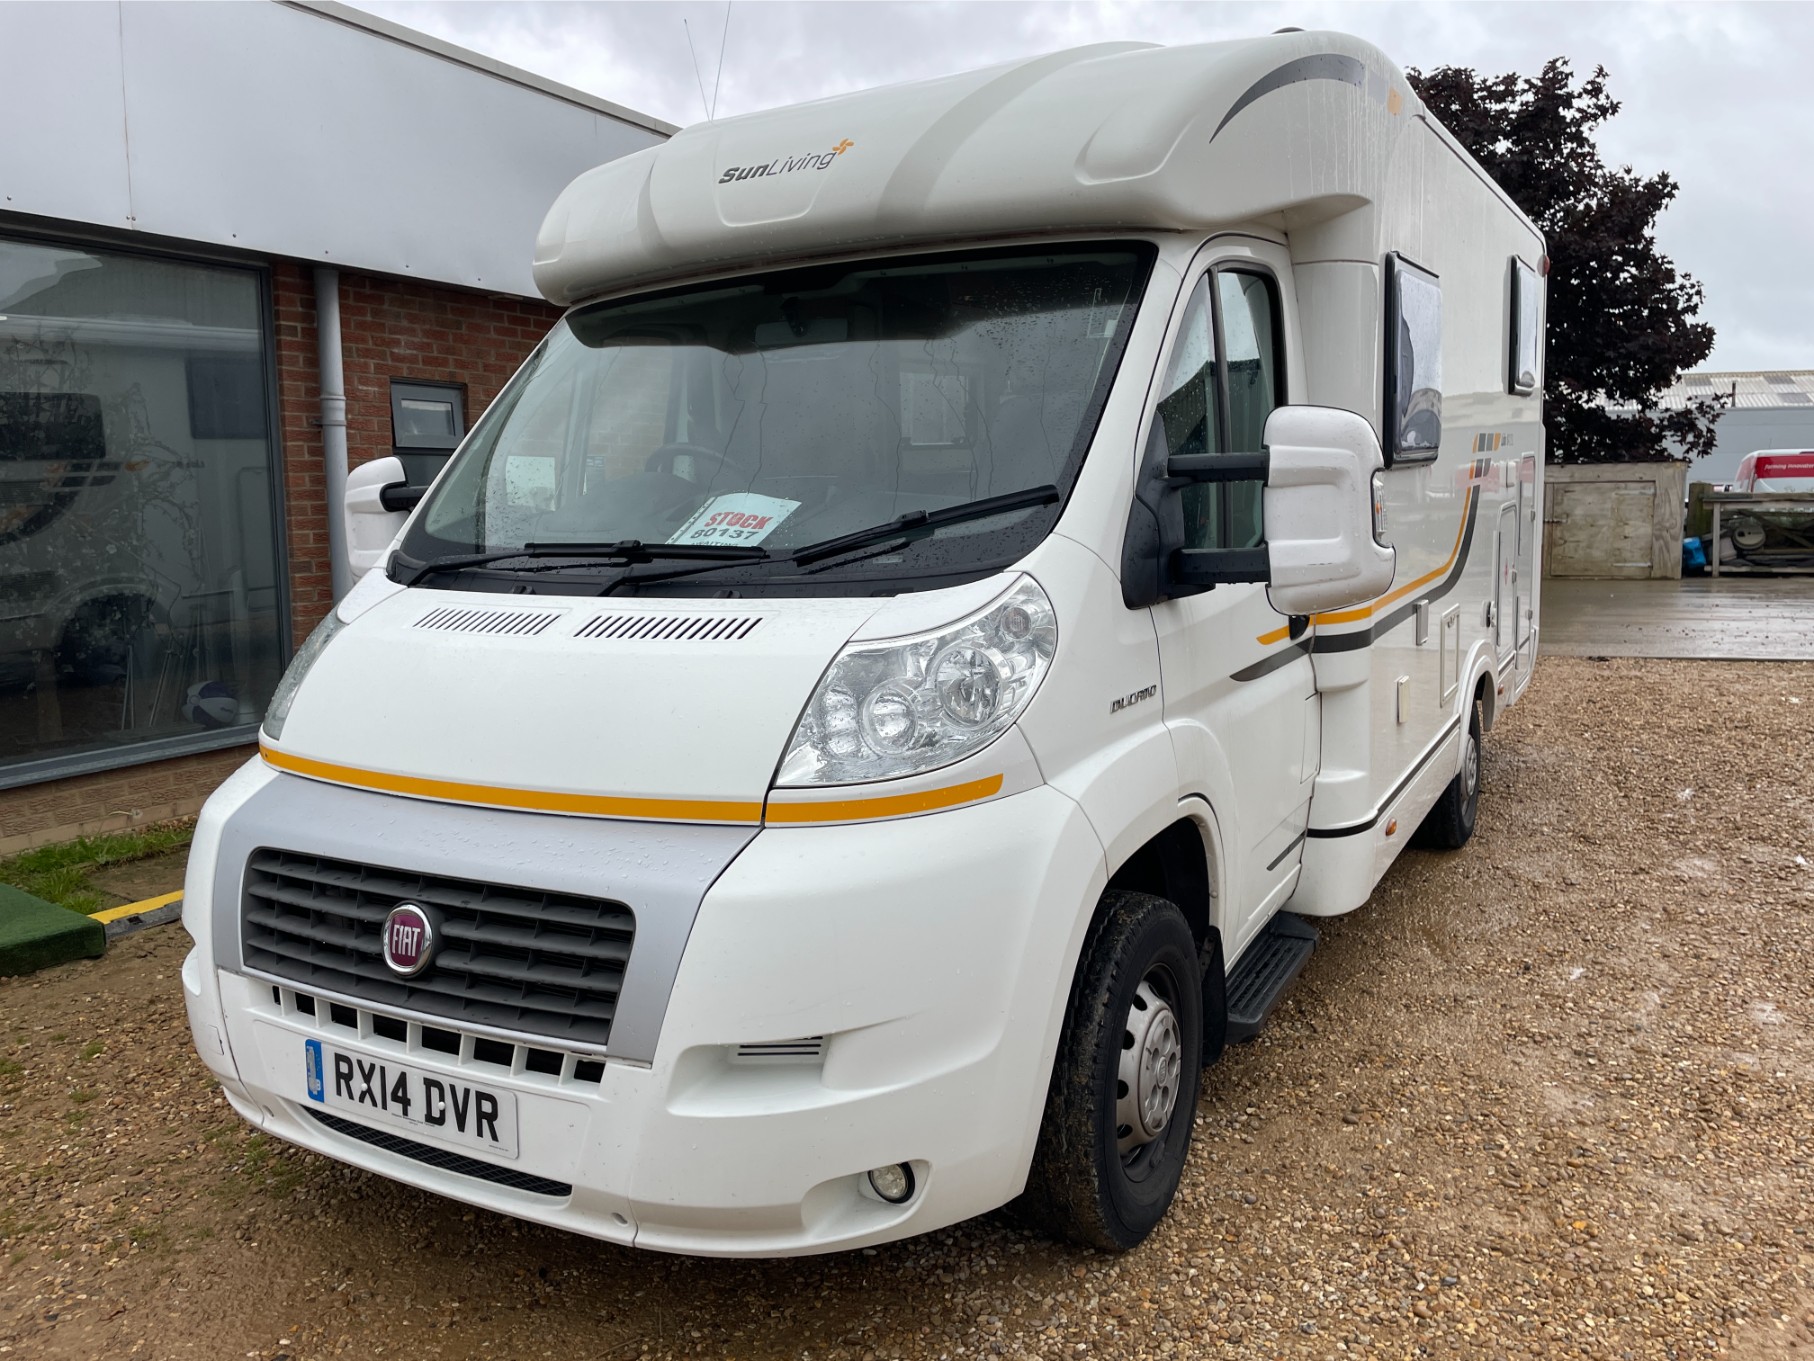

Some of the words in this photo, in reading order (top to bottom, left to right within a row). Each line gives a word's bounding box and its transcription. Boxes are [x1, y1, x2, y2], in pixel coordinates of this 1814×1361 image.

[704, 511, 774, 530] STOCK
[1109, 684, 1157, 715] DUCATO
[391, 924, 421, 957] FIAT
[334, 1052, 412, 1117] RX14
[423, 1076, 499, 1143] DVR
